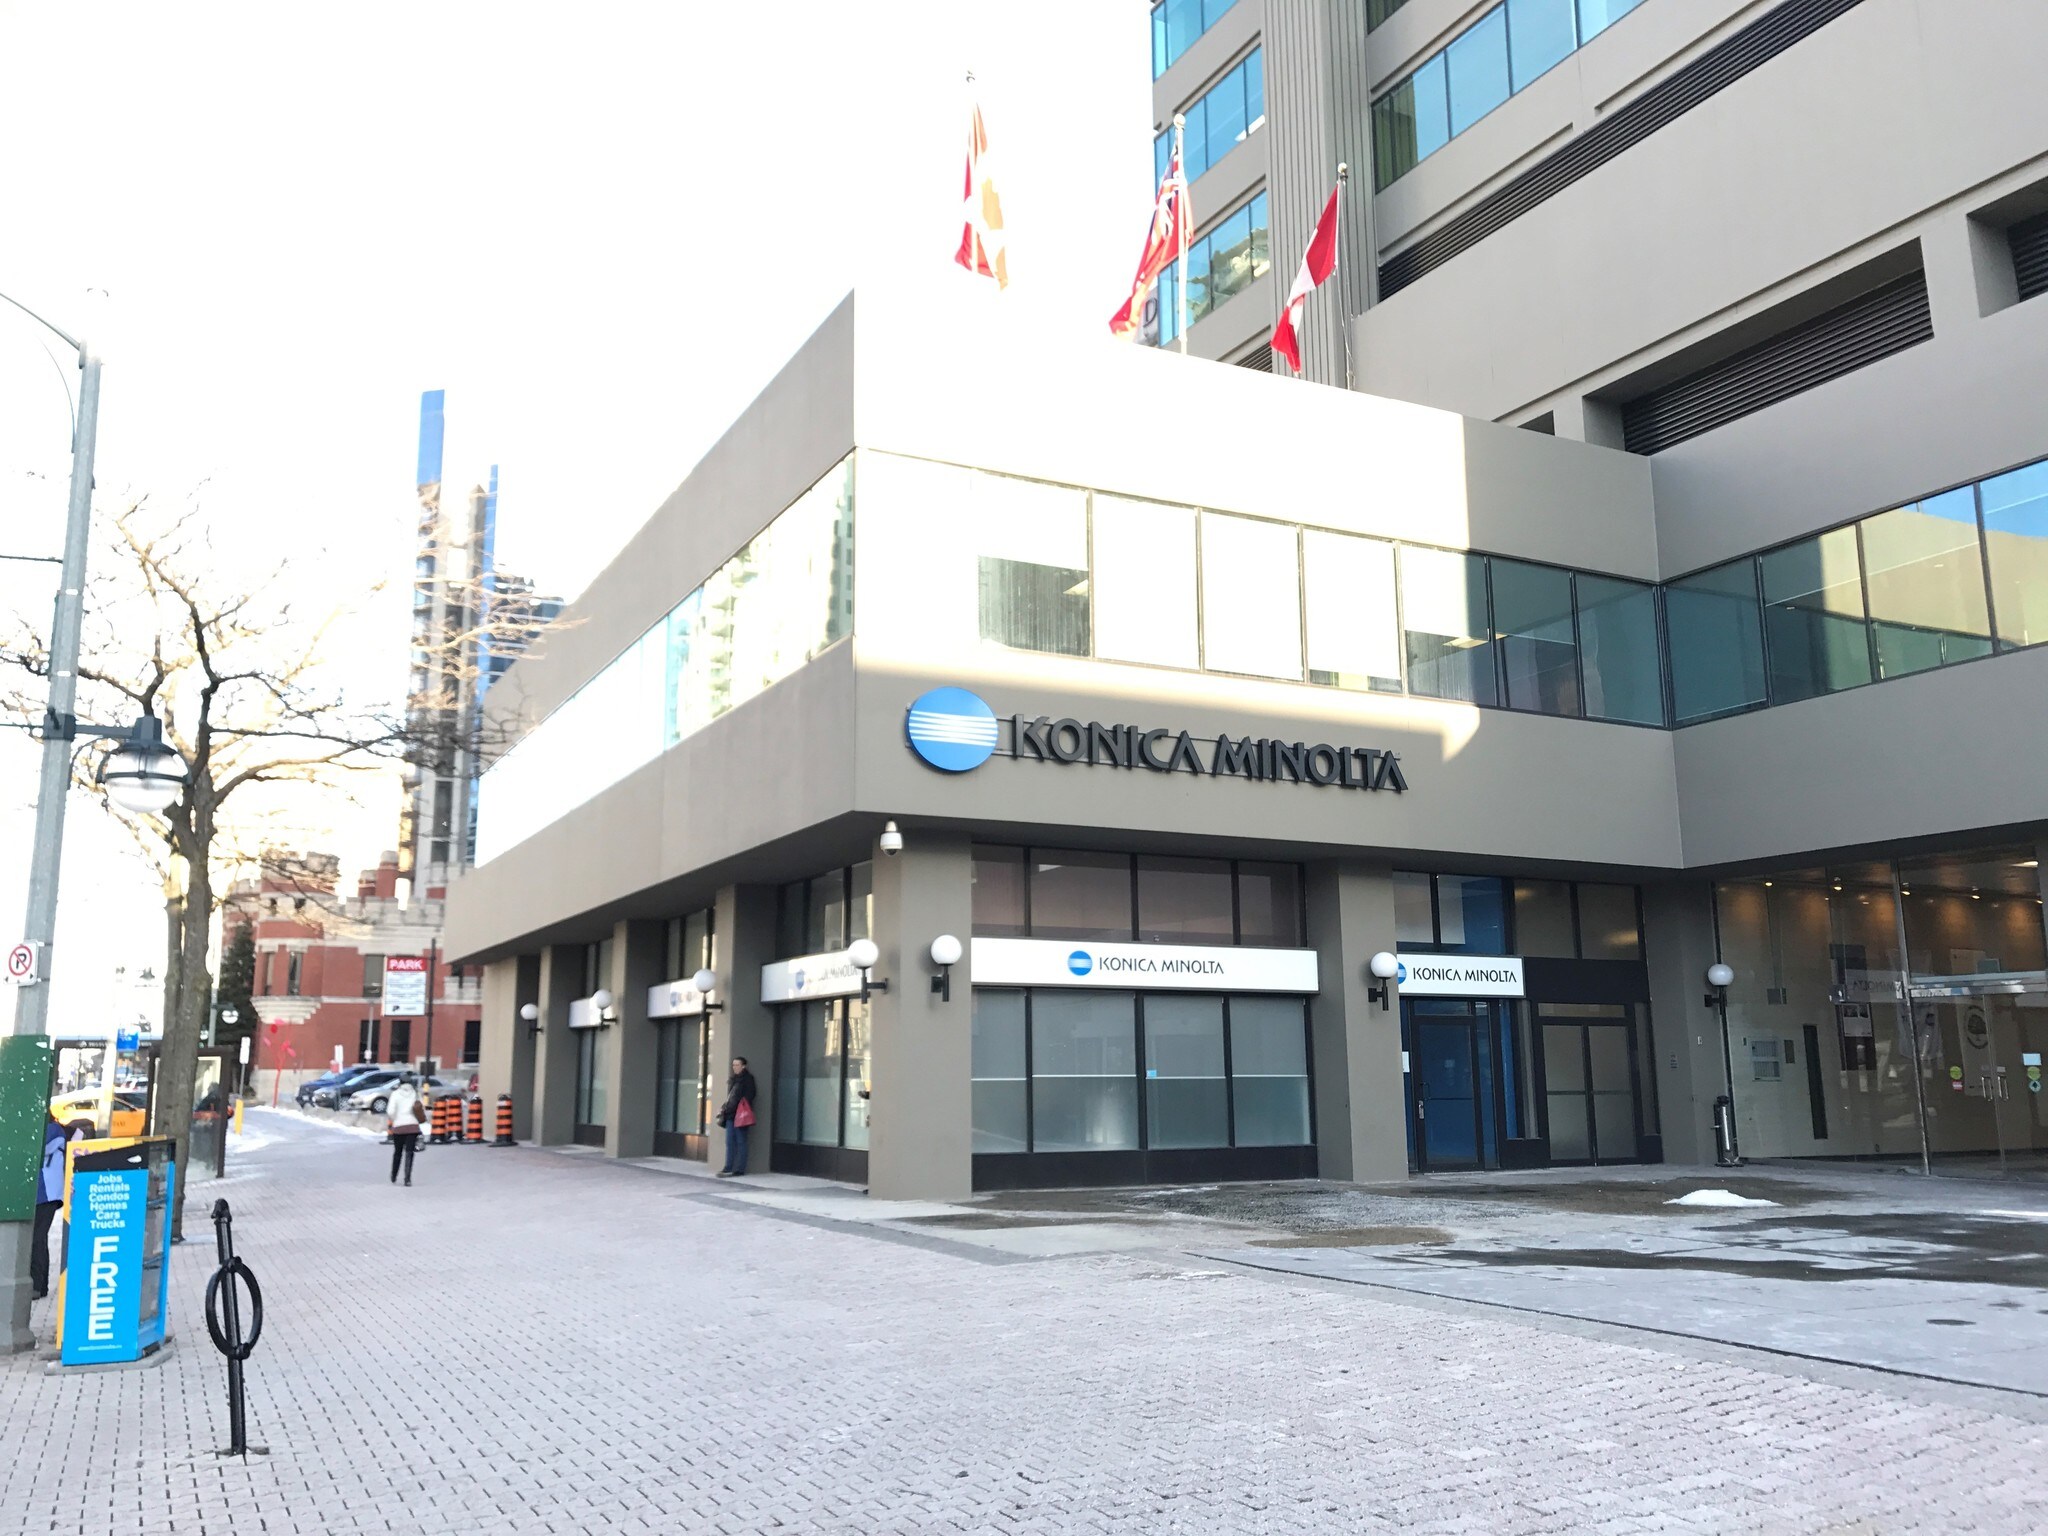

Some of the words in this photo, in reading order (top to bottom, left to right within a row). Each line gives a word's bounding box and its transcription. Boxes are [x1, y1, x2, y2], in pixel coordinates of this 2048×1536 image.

[1012, 713, 1205, 774] KONICA
[1211, 733, 1409, 793] MINOLTA
[389, 958, 423, 970] PARK
[1099, 956, 1157, 972] KONICA
[1161, 959, 1225, 975] MINOLTA
[1413, 967, 1462, 982] KONICA
[1464, 969, 1517, 983] MINOLTA
[97, 1174, 123, 1184] Jobs
[89, 1183, 130, 1193] Rentals
[88, 1192, 130, 1202] Condos
[89, 1201, 128, 1211] Homes
[95, 1210, 121, 1220] Cars
[90, 1219, 126, 1230] Trucks
[87, 1235, 120, 1340] FREE
